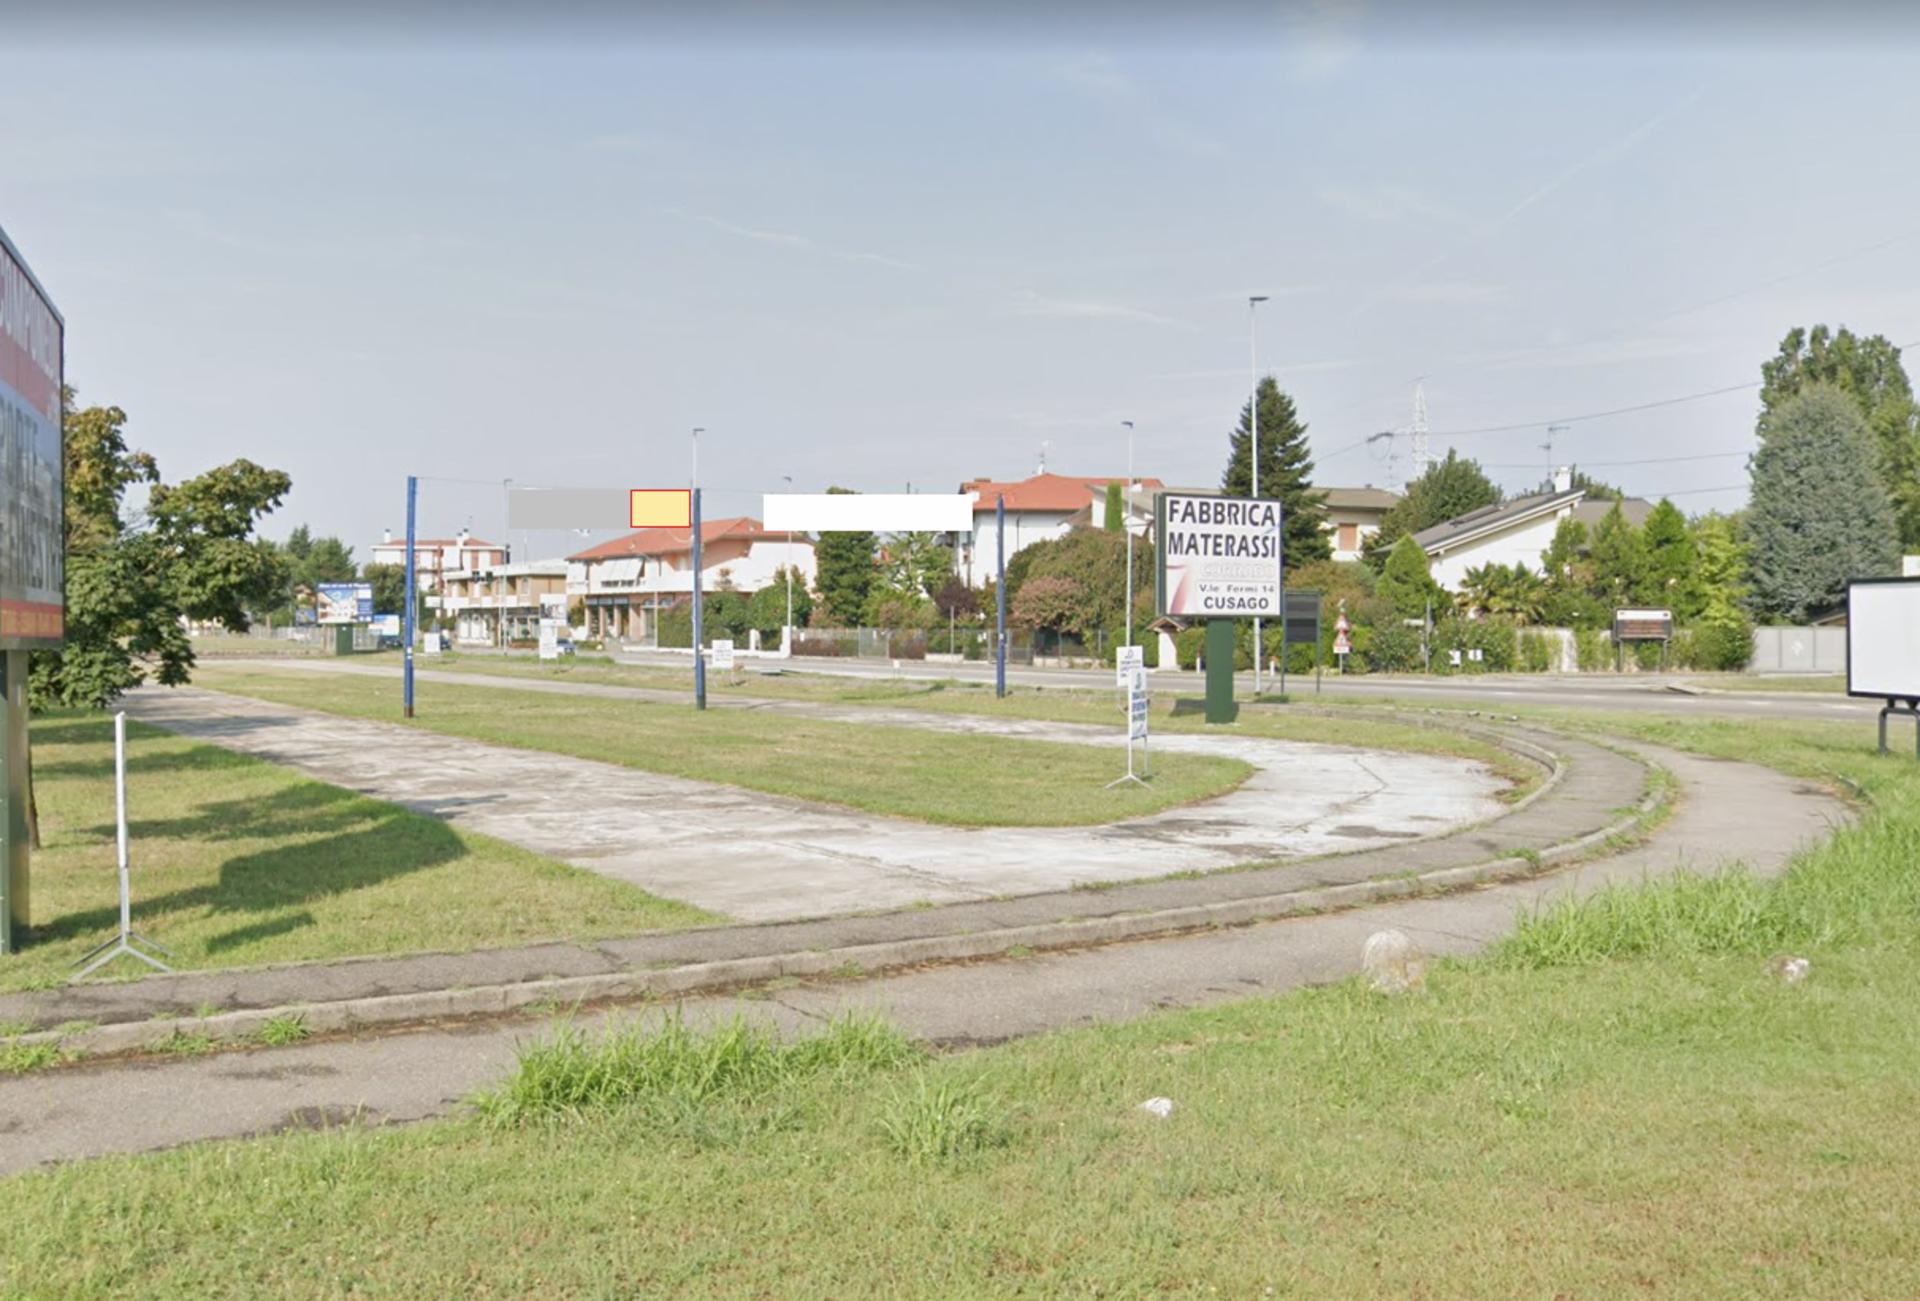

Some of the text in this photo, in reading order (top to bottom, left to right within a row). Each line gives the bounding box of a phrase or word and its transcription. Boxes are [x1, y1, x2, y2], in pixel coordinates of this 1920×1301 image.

[1168, 500, 1276, 527] FABBRICA
[1168, 532, 1276, 558] MATERASSI
[1227, 584, 1258, 593] Fermi
[1203, 596, 1269, 610] CUSAGO
